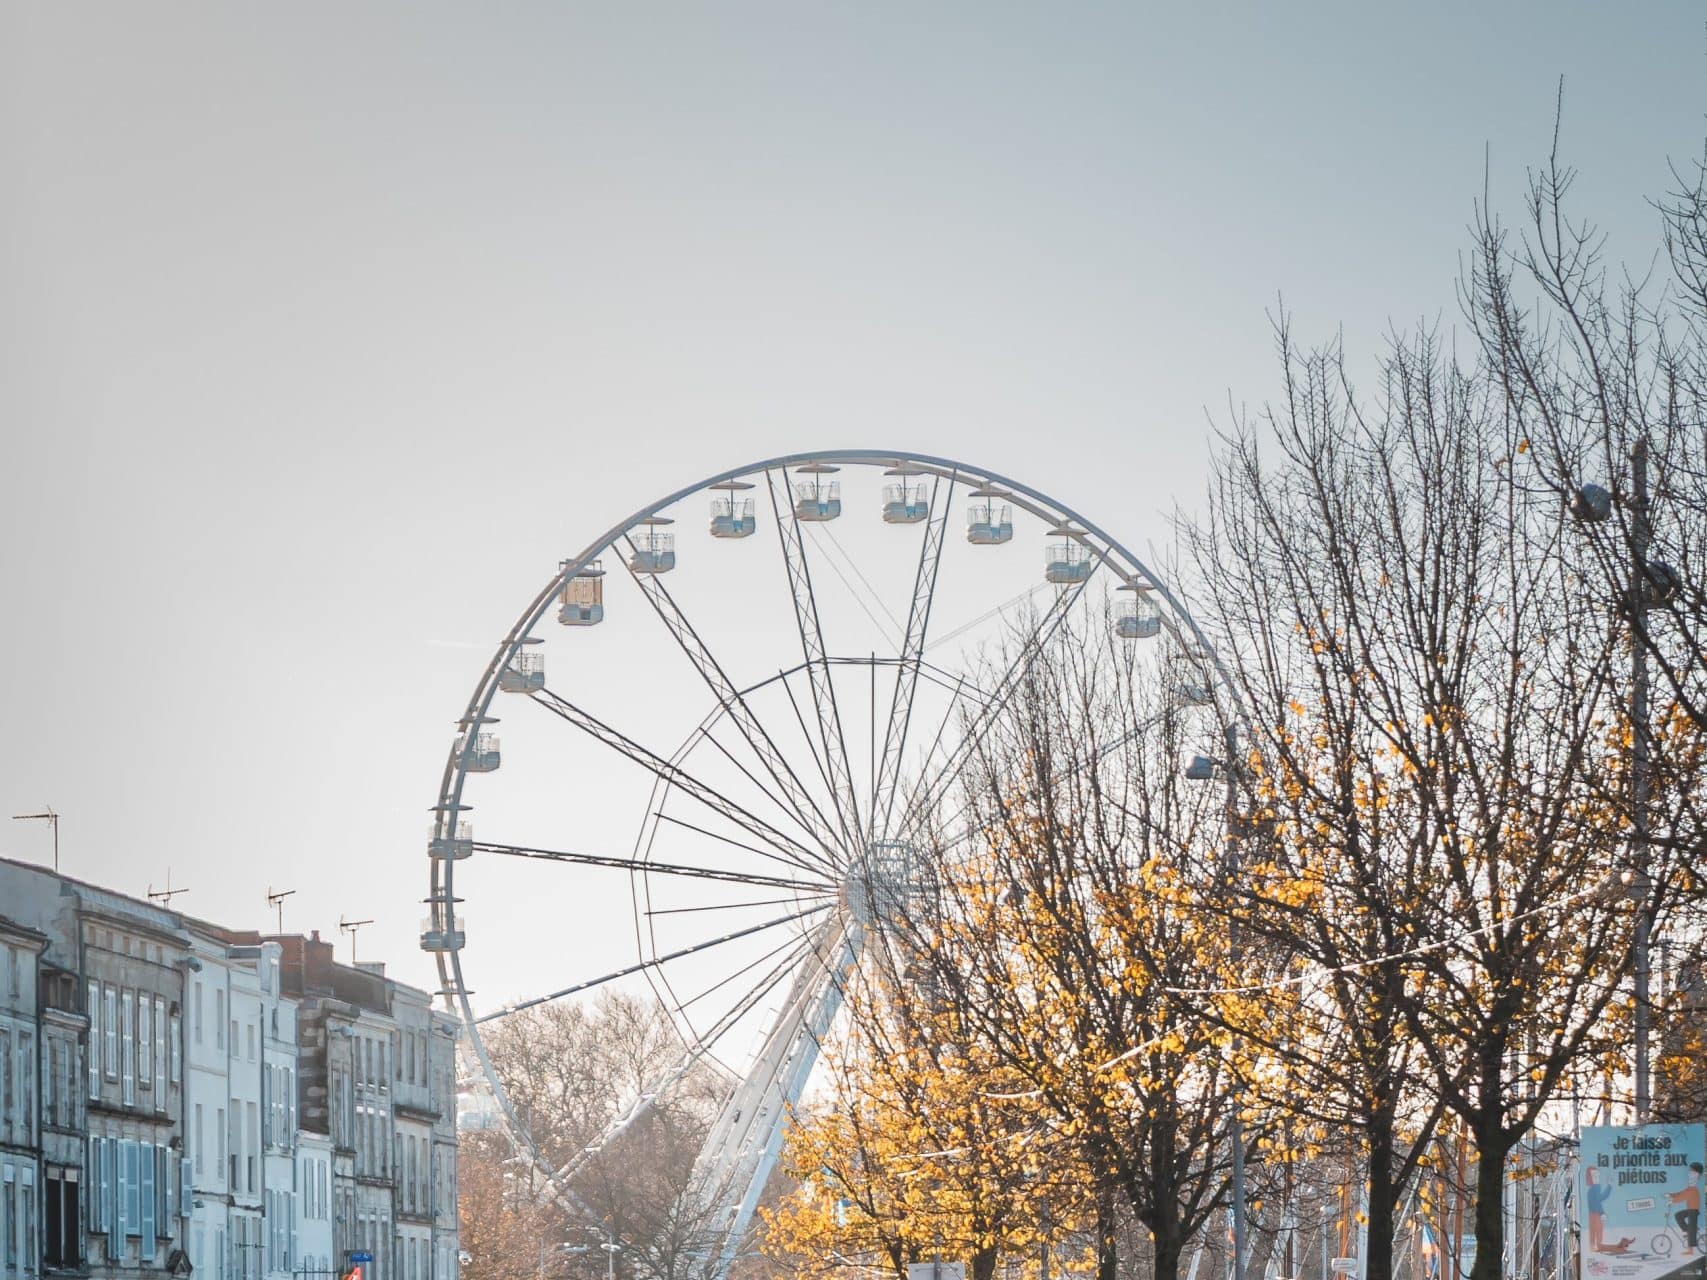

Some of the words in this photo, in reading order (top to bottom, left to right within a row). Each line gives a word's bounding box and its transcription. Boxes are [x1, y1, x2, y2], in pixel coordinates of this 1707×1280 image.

[1613, 1135, 1629, 1150] Je
[1631, 1134, 1672, 1150] laisse
[1597, 1153, 1609, 1168] la
[1612, 1150, 1661, 1170] priorité
[1664, 1153, 1688, 1167] aux
[1618, 1168, 1667, 1187] piétons
